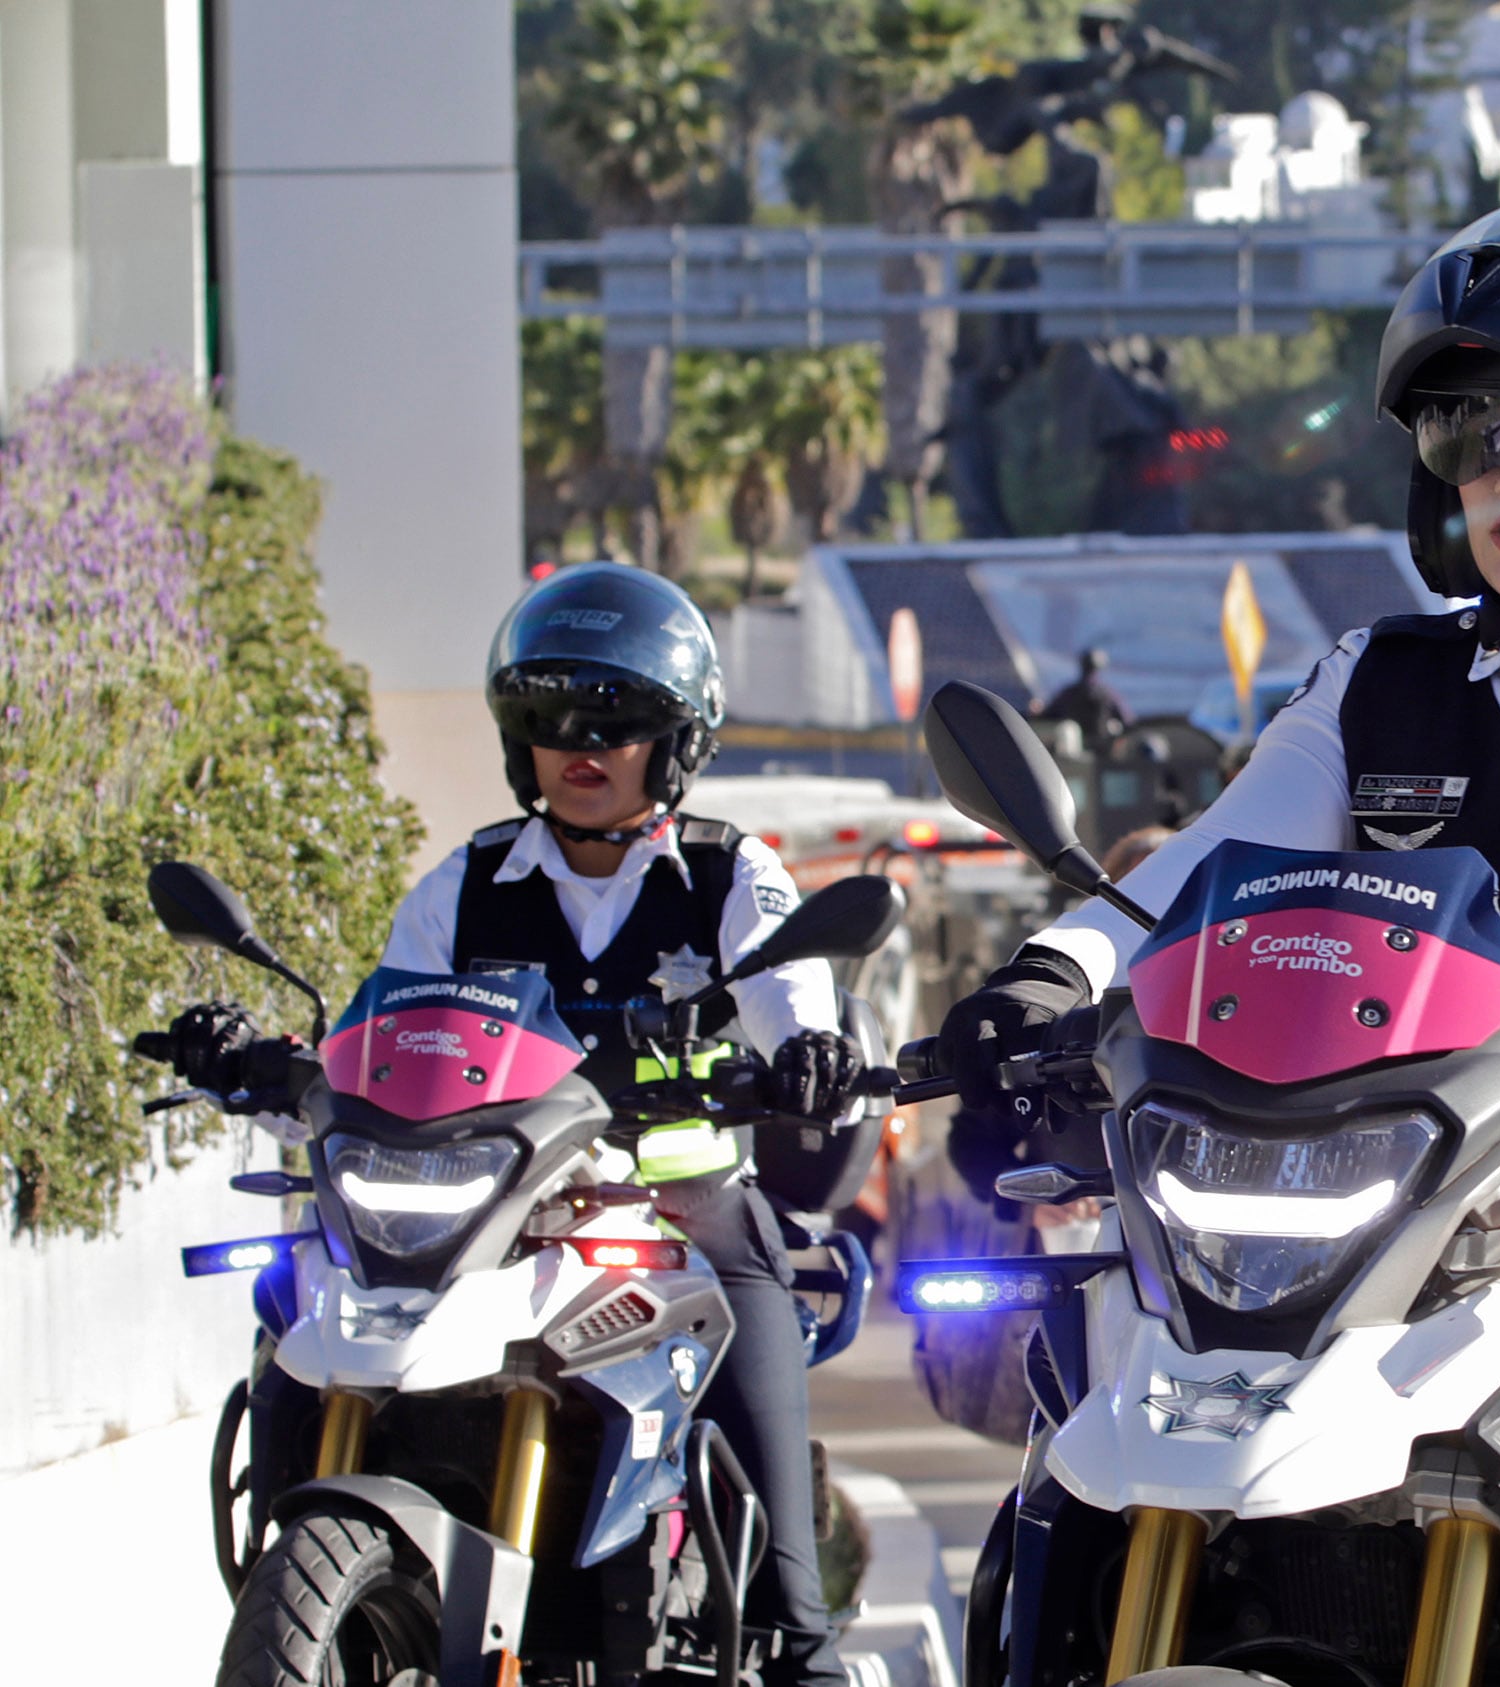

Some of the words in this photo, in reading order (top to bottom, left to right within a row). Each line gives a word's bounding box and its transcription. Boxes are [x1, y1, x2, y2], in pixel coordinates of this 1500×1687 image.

[1250, 932, 1353, 959] Contigo
[1257, 954, 1278, 964] con
[1276, 953, 1364, 978] rumbo
[396, 1028, 463, 1047] Contigo
[412, 1041, 469, 1059] rumbo
